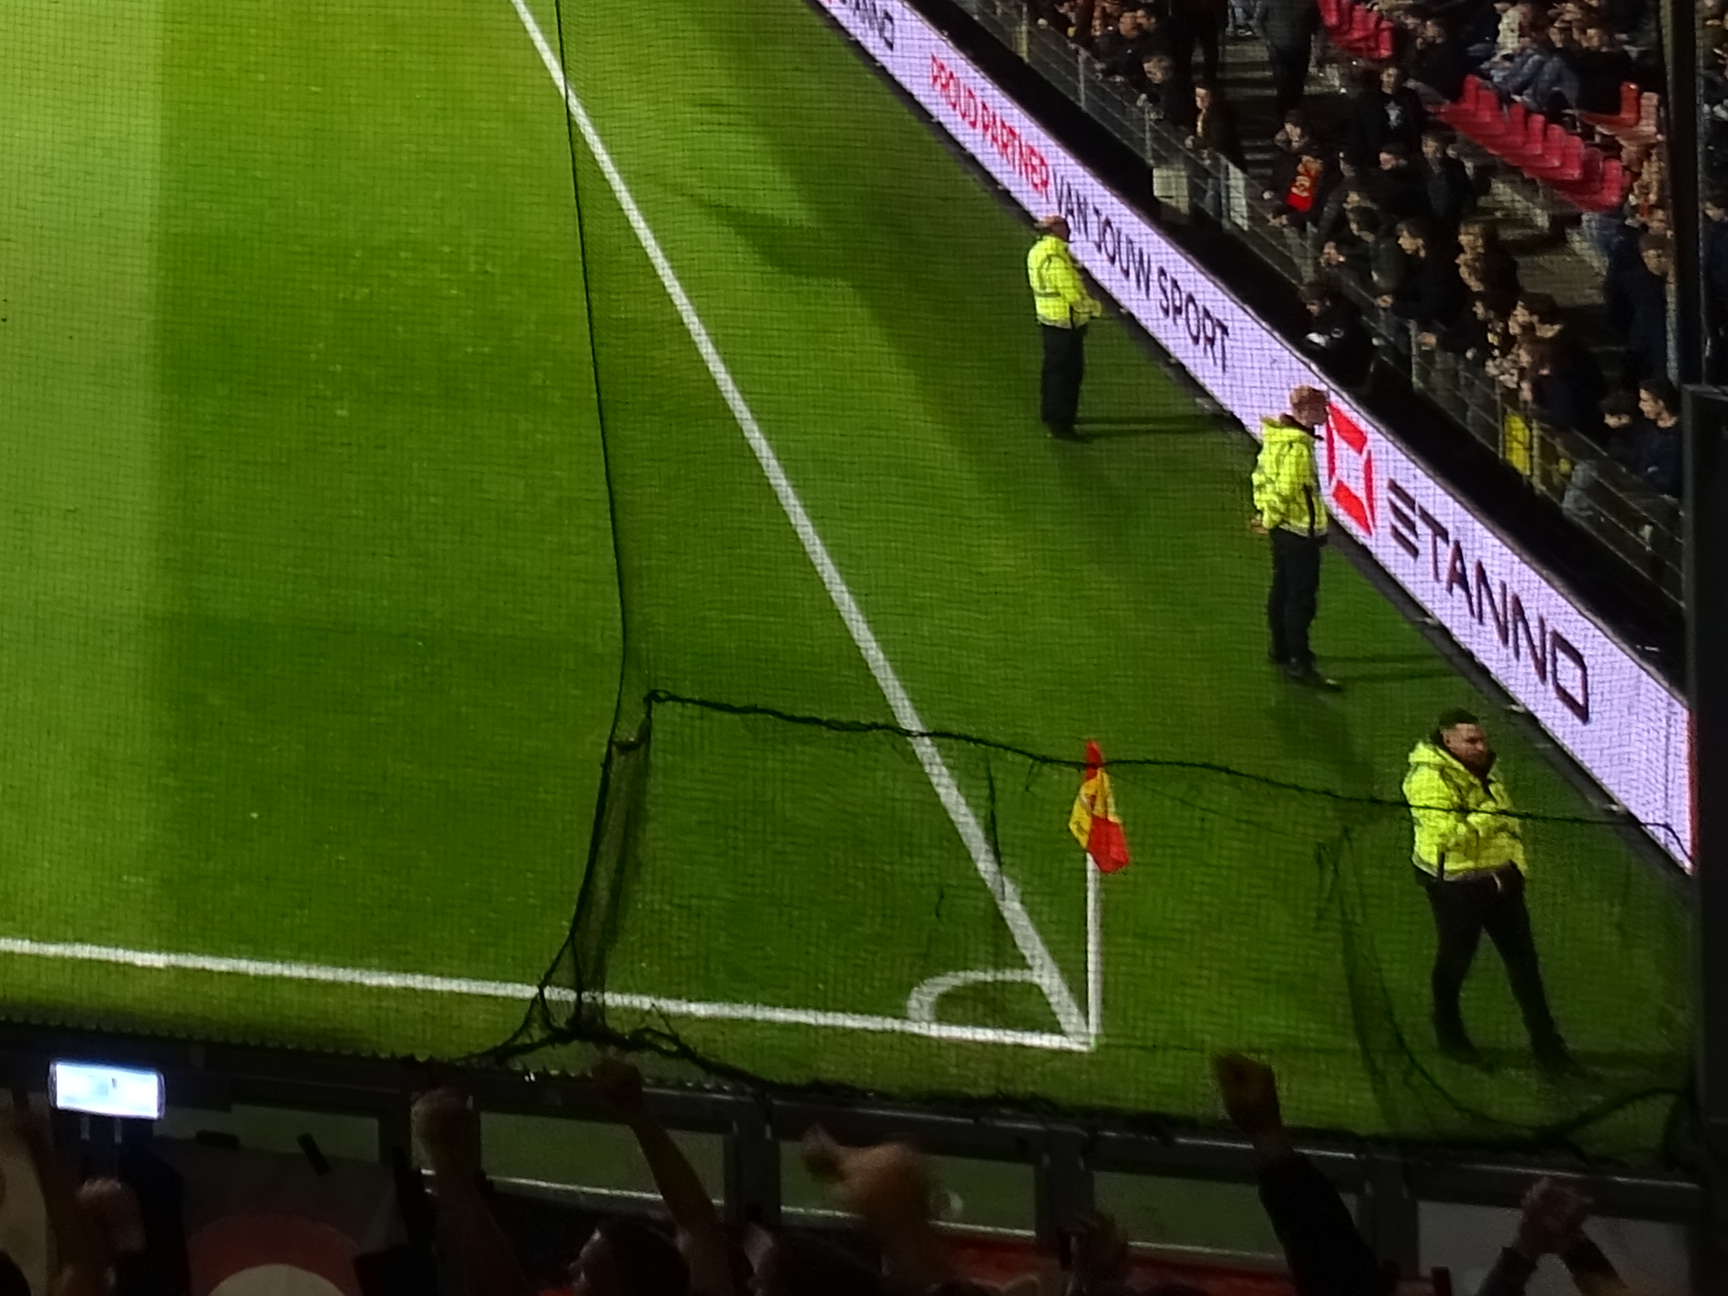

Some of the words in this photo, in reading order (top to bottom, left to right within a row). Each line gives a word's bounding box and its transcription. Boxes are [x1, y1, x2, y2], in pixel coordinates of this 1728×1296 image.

[931, 52, 979, 131] PROUD
[979, 99, 1051, 204] PARTNER
[1052, 168, 1089, 242] VAN
[1092, 204, 1152, 301] JOUW
[1157, 267, 1231, 374] SPORT
[1386, 476, 1590, 725] STANNO
